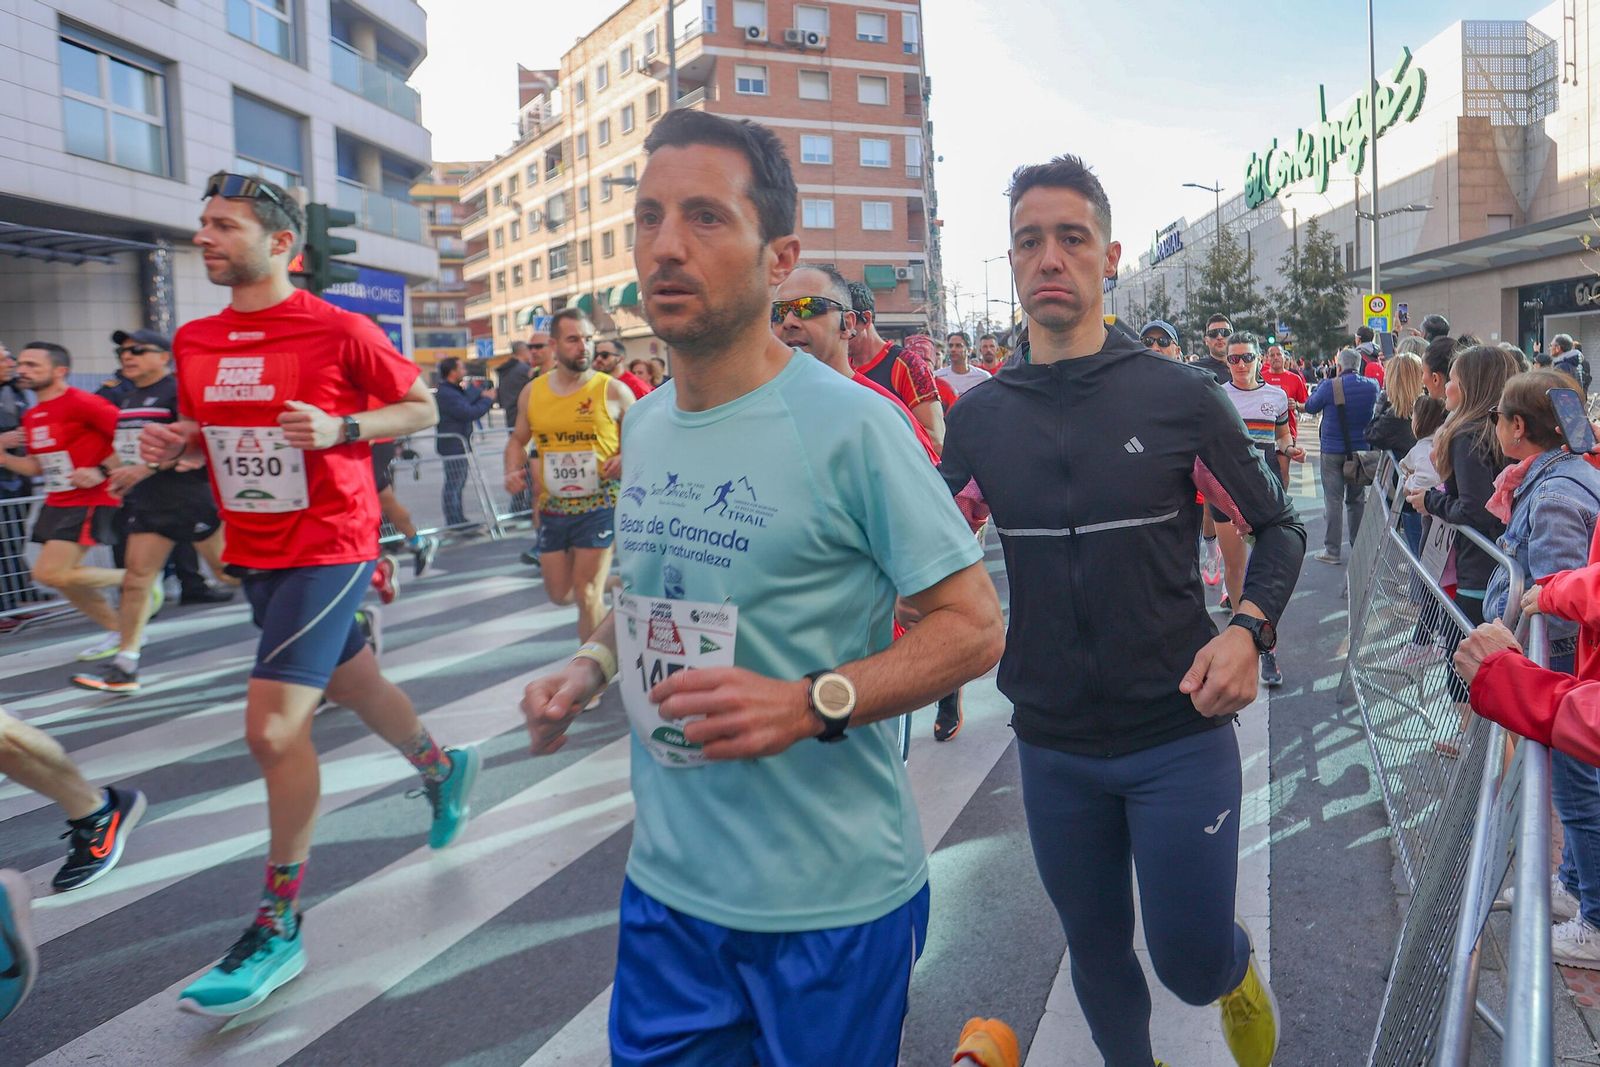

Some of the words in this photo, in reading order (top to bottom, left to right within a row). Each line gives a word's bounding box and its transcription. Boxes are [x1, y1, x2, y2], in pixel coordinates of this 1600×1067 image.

[1372, 301, 1384, 309] 30
[555, 431, 598, 443] Vigilsa
[223, 456, 282, 477] 1530
[553, 467, 586, 479] 3091
[728, 509, 767, 528] TRAIL
[646, 515, 665, 536] de
[669, 517, 750, 552] Granada
[659, 543, 668, 556] y
[668, 545, 731, 569] naturaleza
